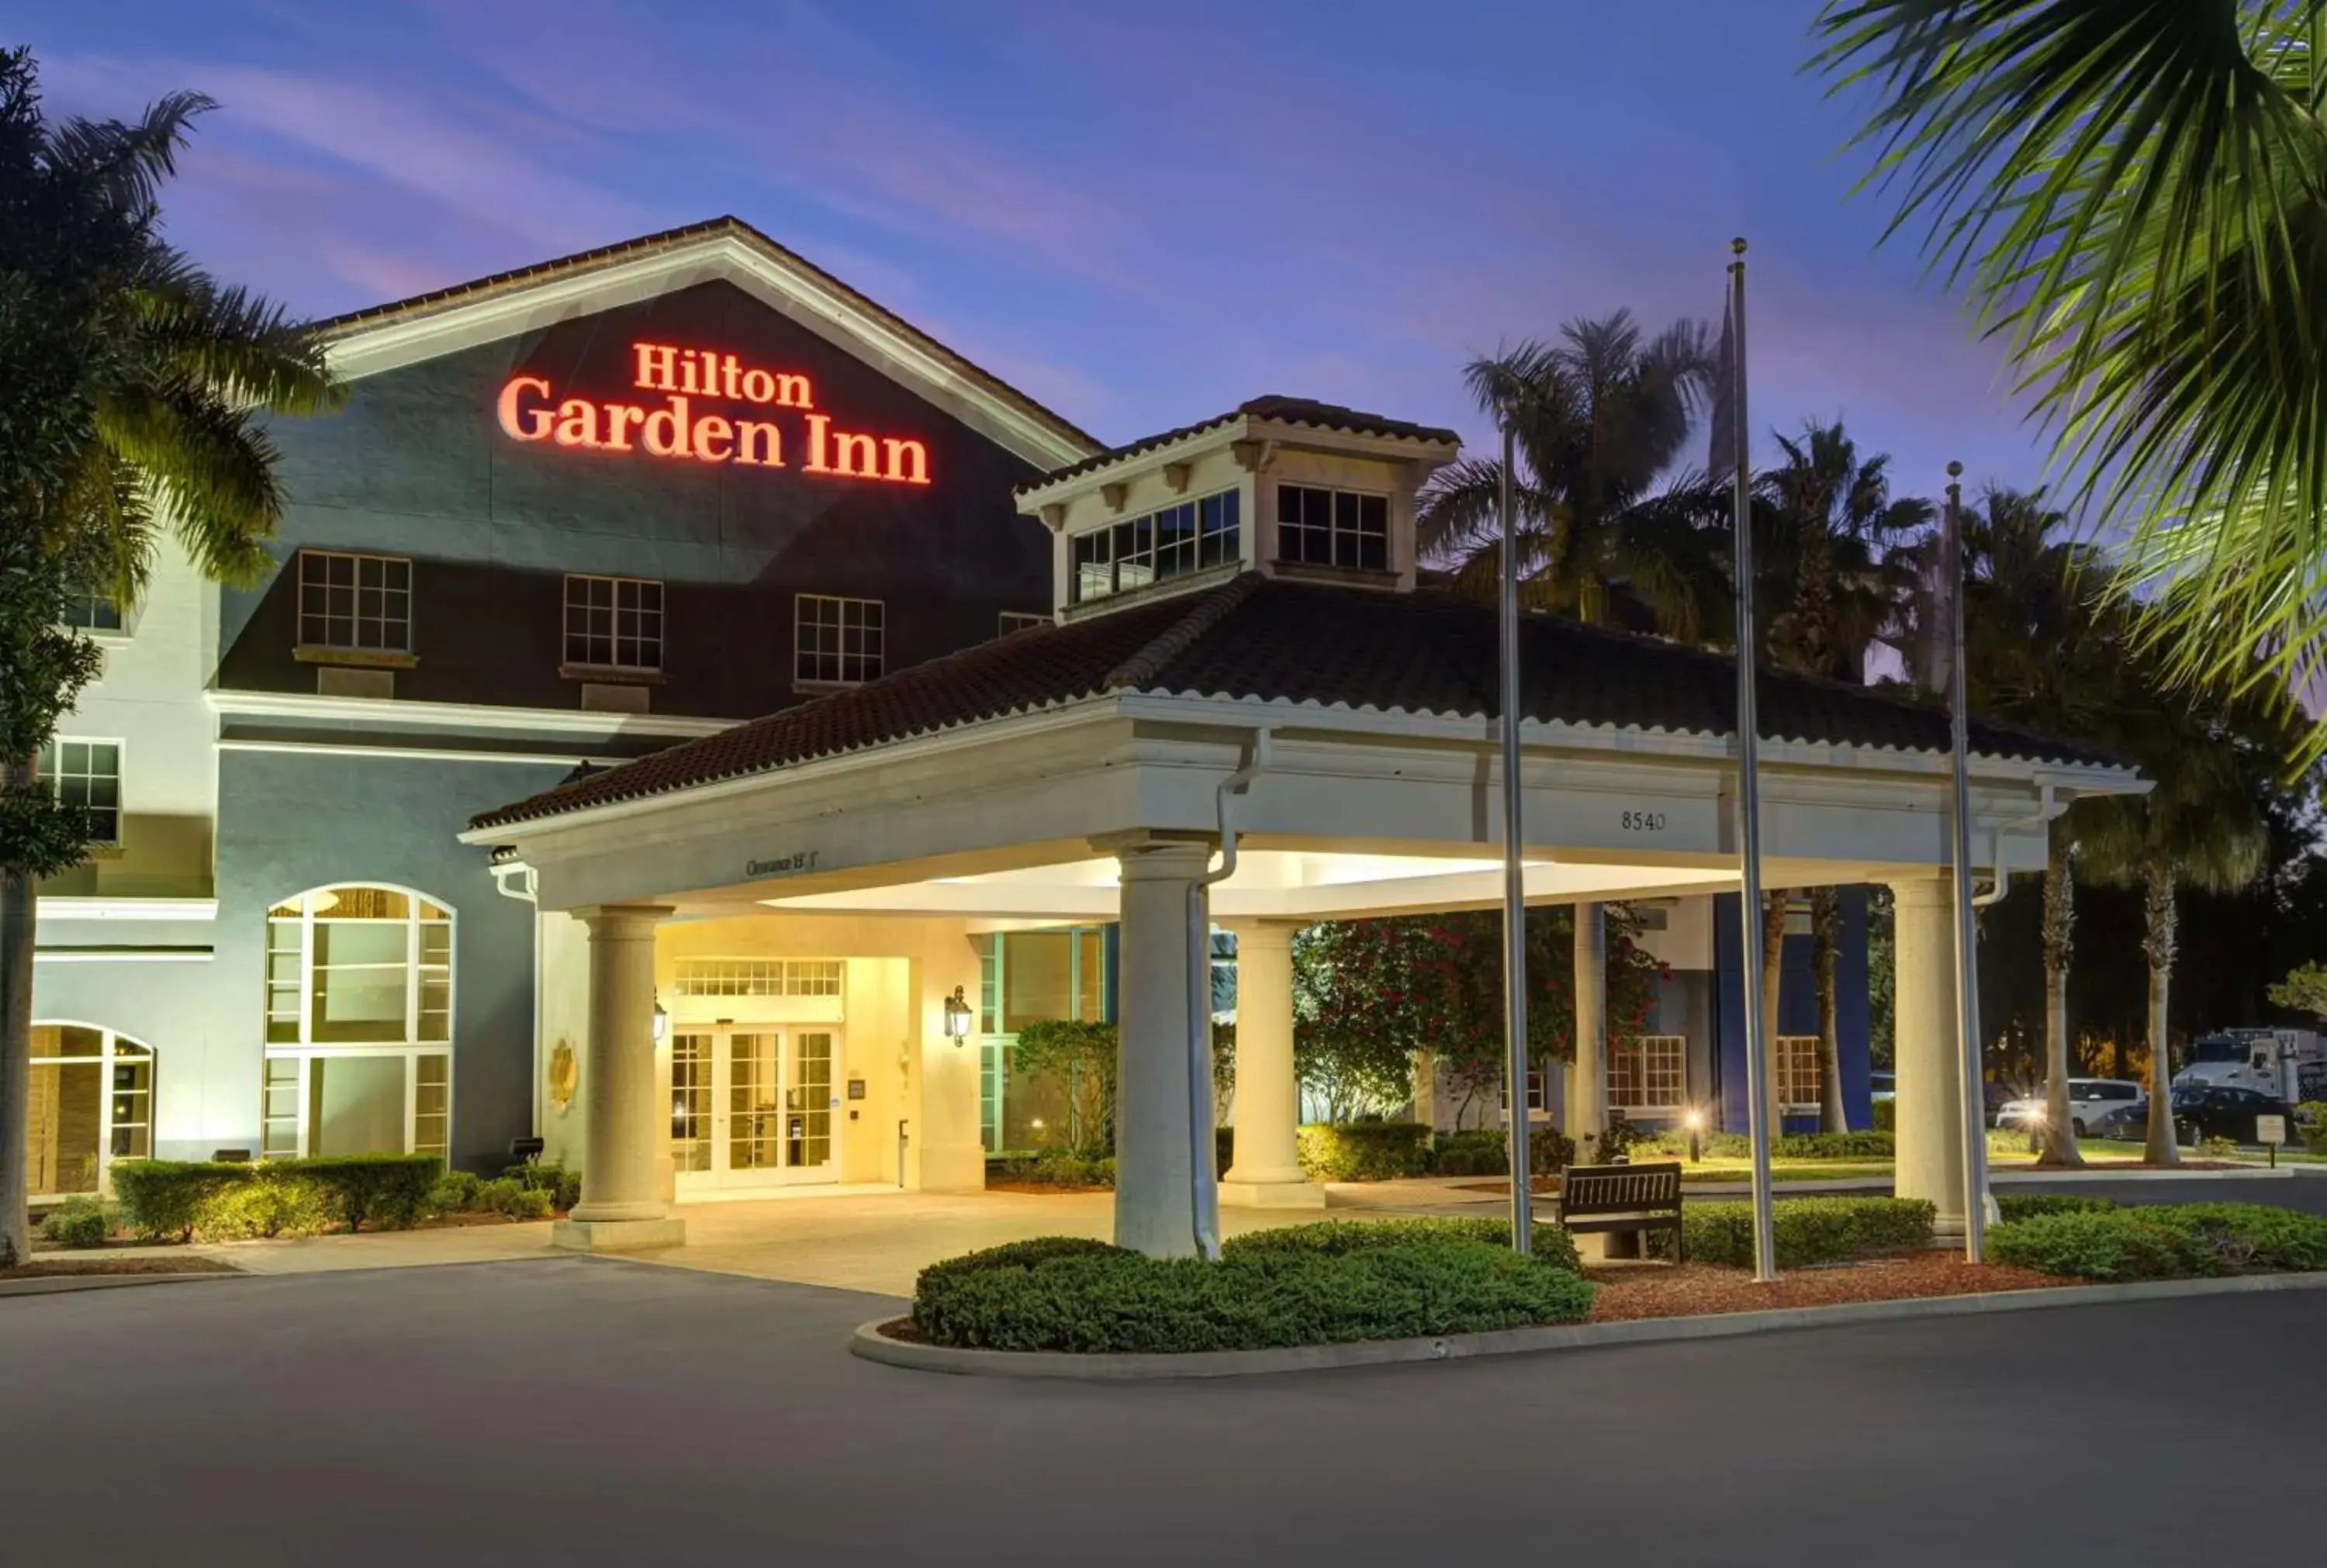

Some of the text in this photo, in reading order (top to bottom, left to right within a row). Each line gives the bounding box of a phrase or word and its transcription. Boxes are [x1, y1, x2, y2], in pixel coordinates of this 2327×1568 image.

[632, 343, 814, 409] Hilton
[497, 377, 931, 484] Garden Inn
[1622, 811, 1665, 831] 8540
